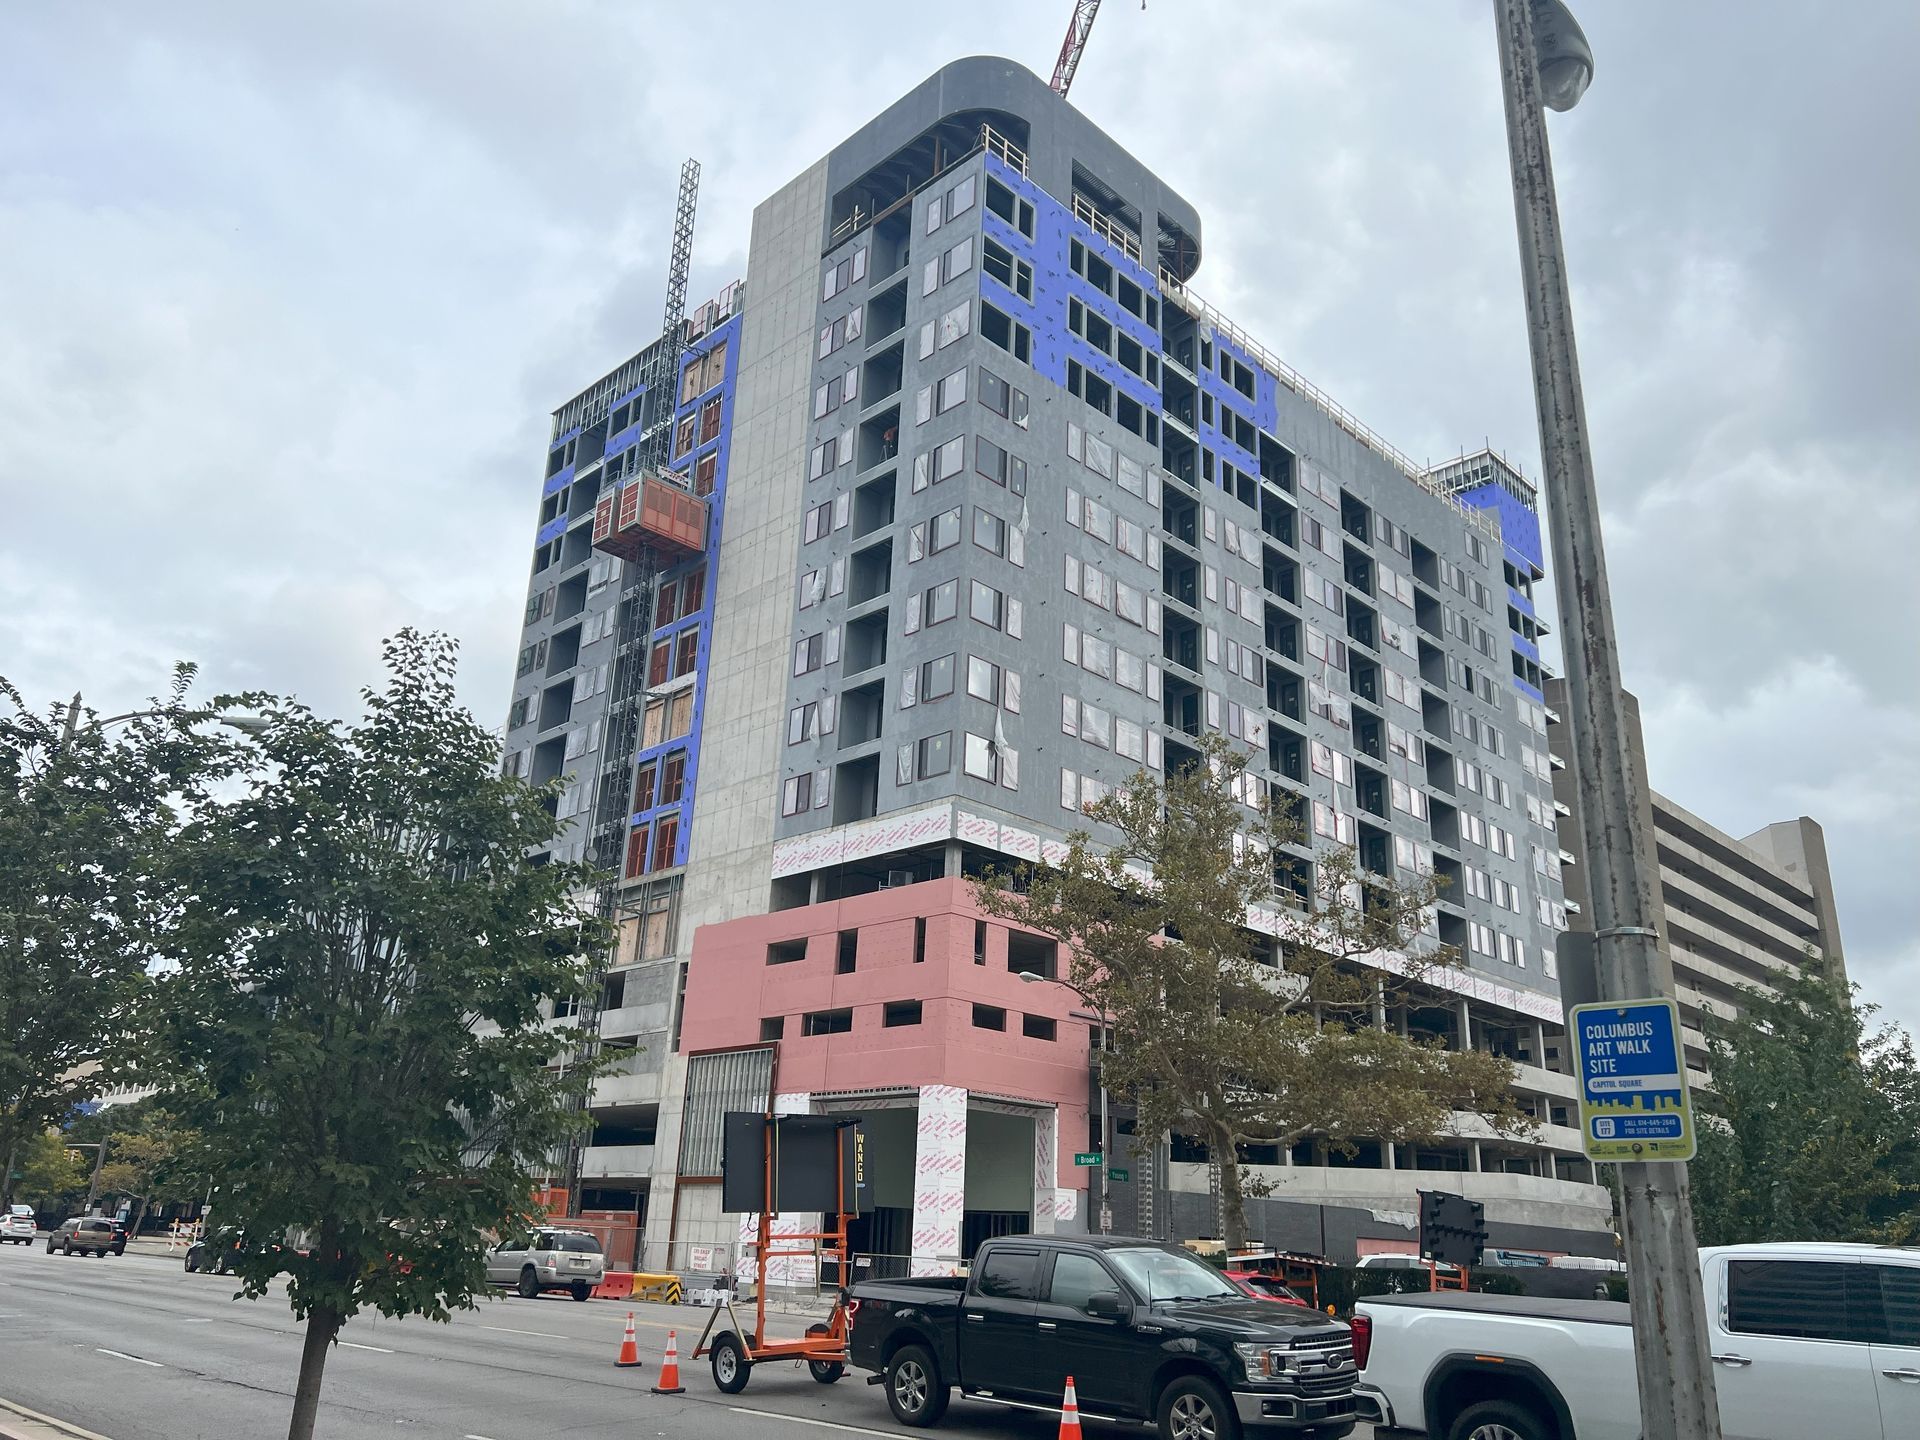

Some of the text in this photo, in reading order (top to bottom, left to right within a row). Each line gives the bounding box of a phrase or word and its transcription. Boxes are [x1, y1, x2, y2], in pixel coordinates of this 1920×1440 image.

[1586, 1021, 1653, 1039] COLUMBUS
[1589, 1039, 1651, 1056] ART WALK
[1590, 1059, 1617, 1073] SITE
[856, 1134, 865, 1181] WANCO
[1081, 1156, 1095, 1164] Broad
